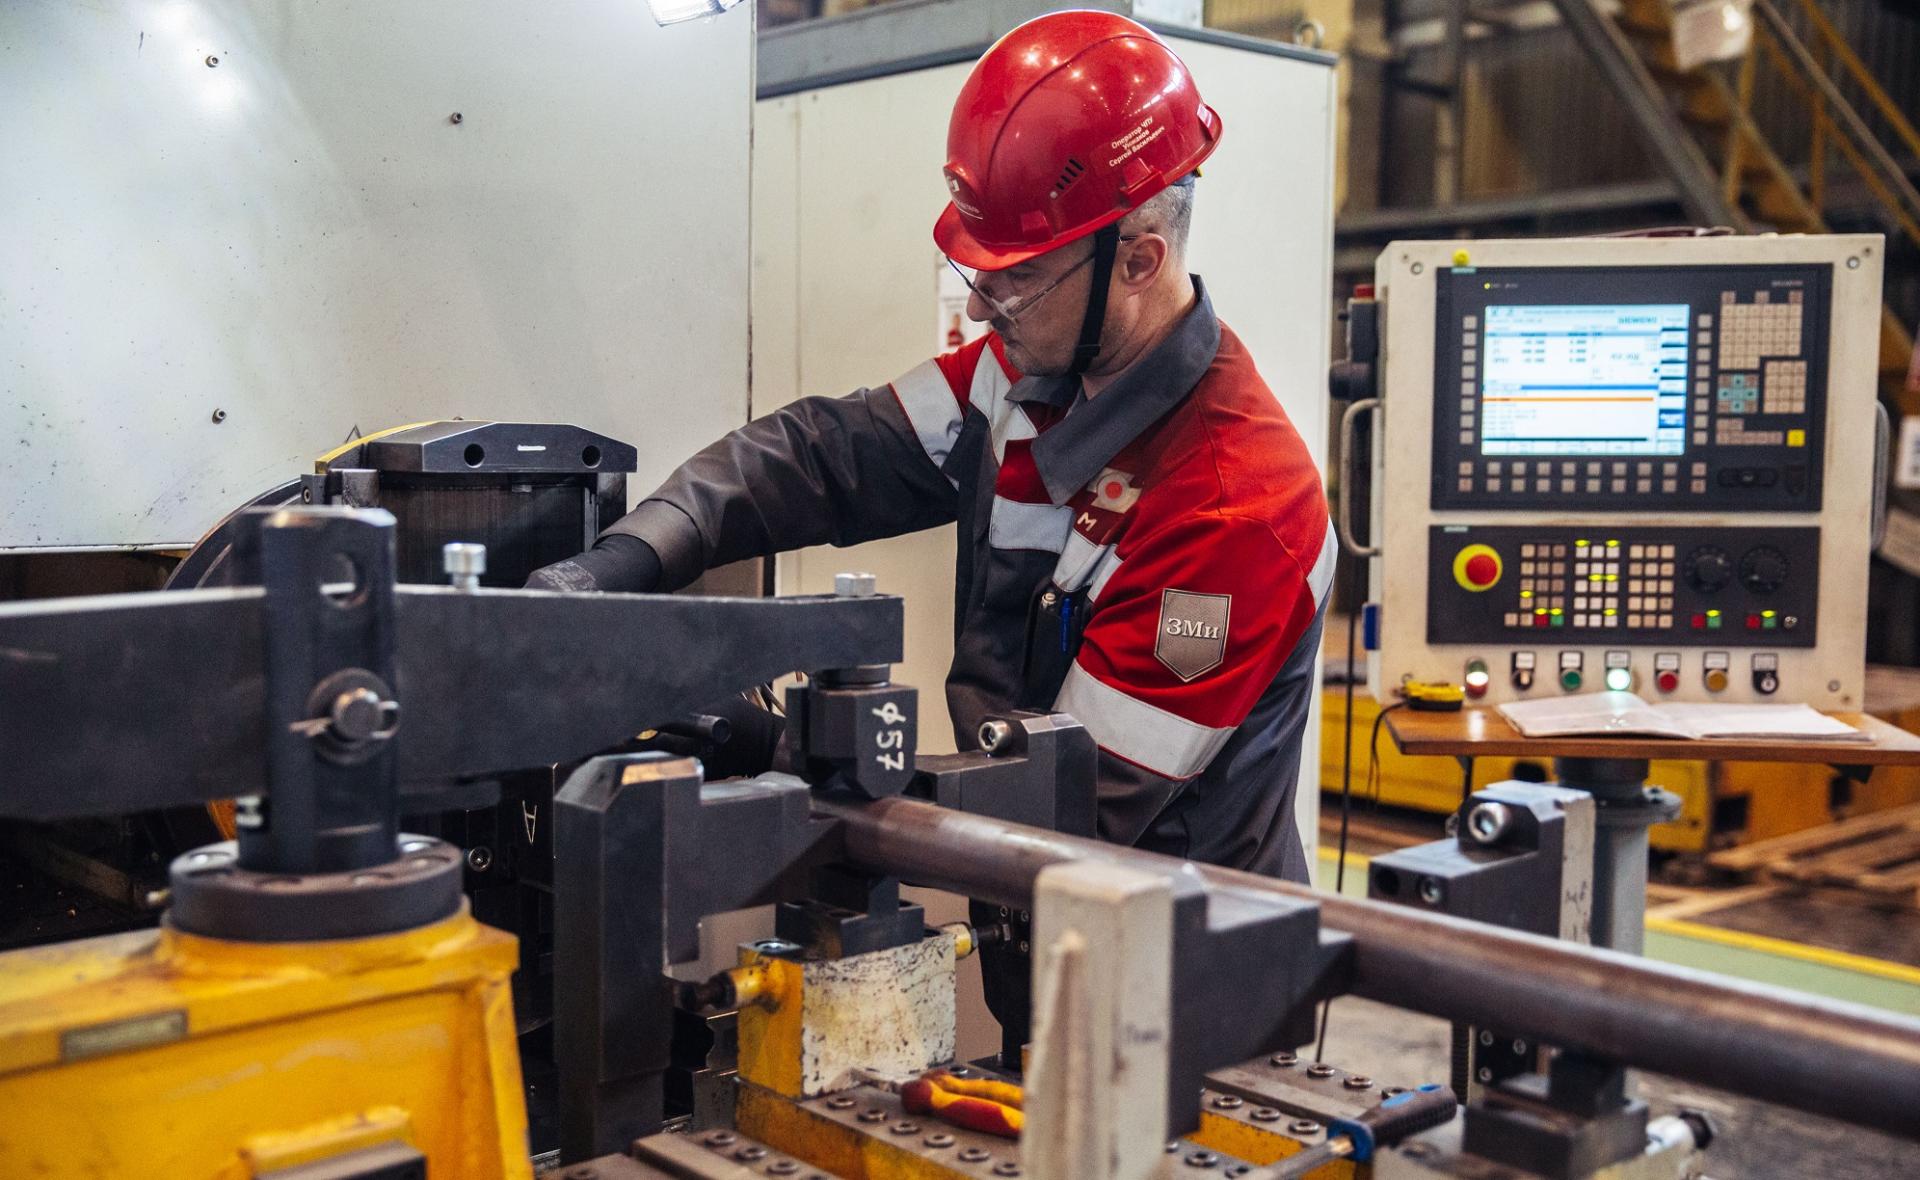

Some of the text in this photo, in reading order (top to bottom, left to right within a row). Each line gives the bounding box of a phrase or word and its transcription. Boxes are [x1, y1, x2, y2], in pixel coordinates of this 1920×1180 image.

[1109, 126, 1165, 167] Сергей Васильевич
[1111, 116, 1153, 149] Оператор ЧПУ
[1166, 617, 1219, 639] ЗМи
